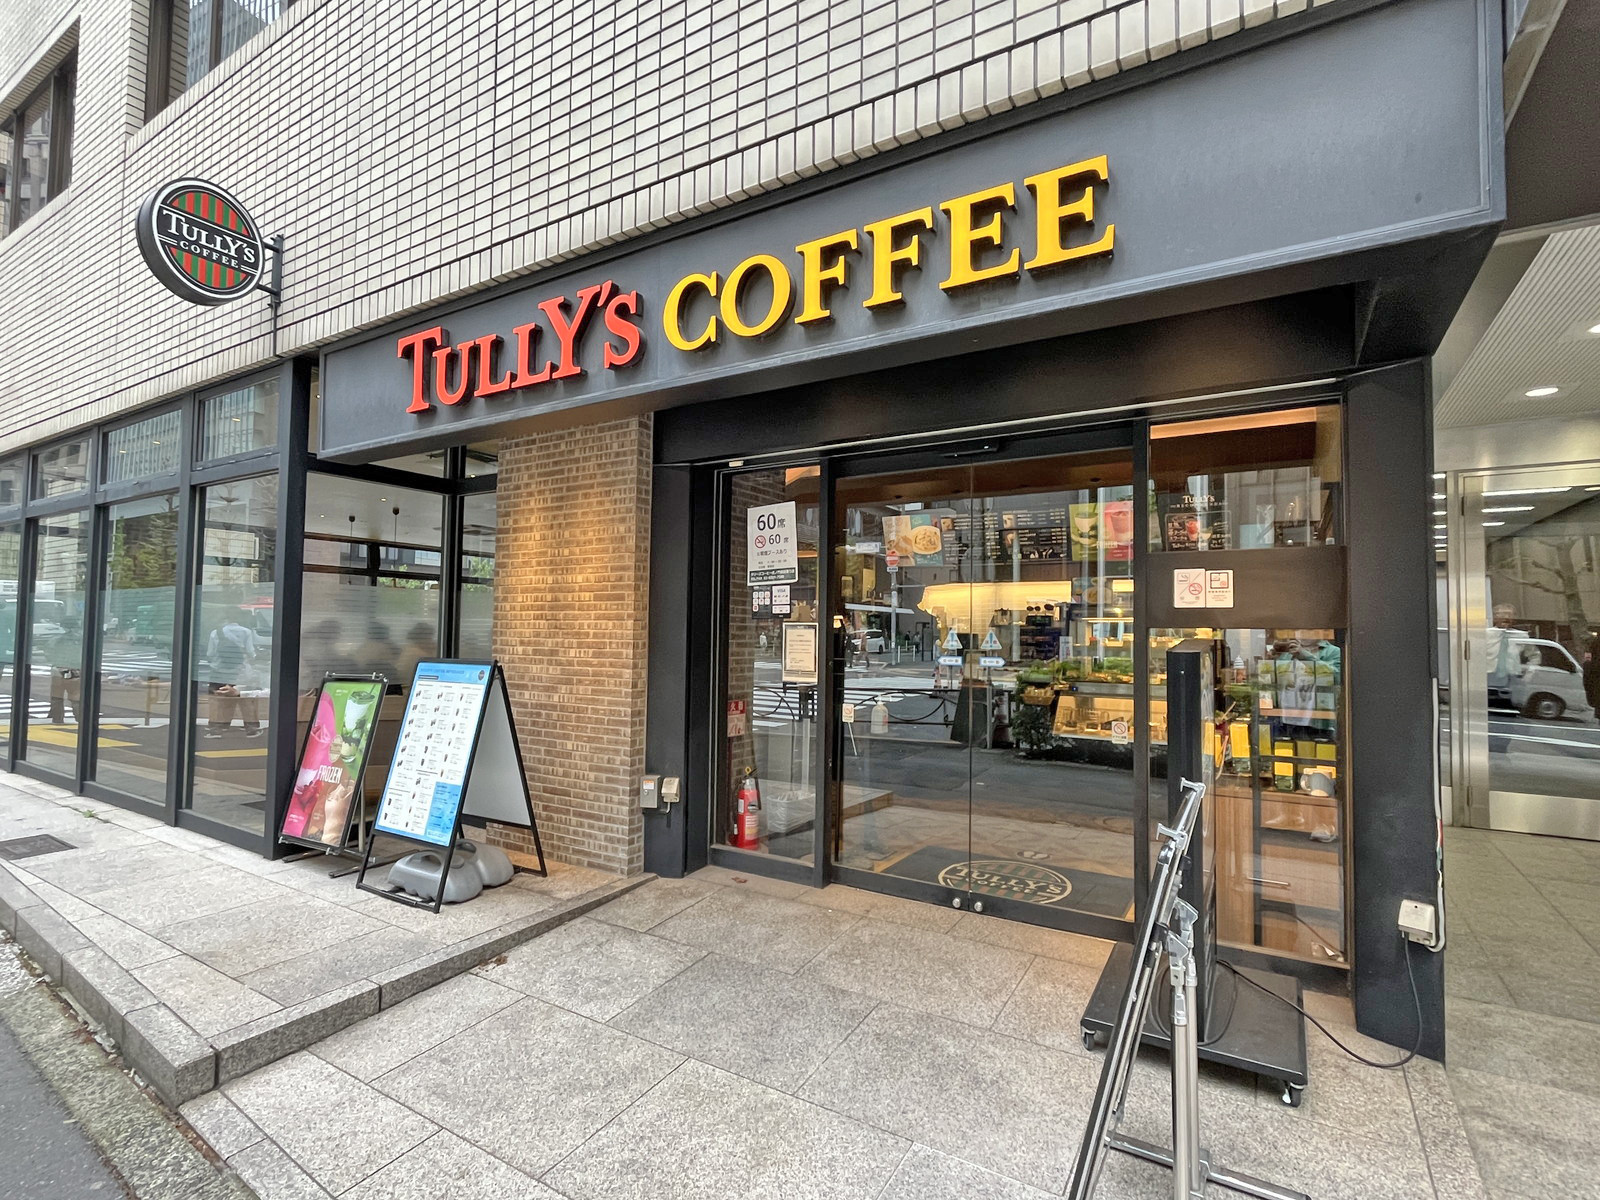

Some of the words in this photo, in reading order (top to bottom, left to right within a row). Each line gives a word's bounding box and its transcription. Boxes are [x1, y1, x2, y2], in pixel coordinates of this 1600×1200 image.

[162, 209, 256, 263] TULLY'S
[179, 240, 239, 268] COFFEE
[397, 279, 642, 415] TULLY'S
[662, 154, 1117, 351] COFFEE
[317, 765, 343, 784] FROZEN
